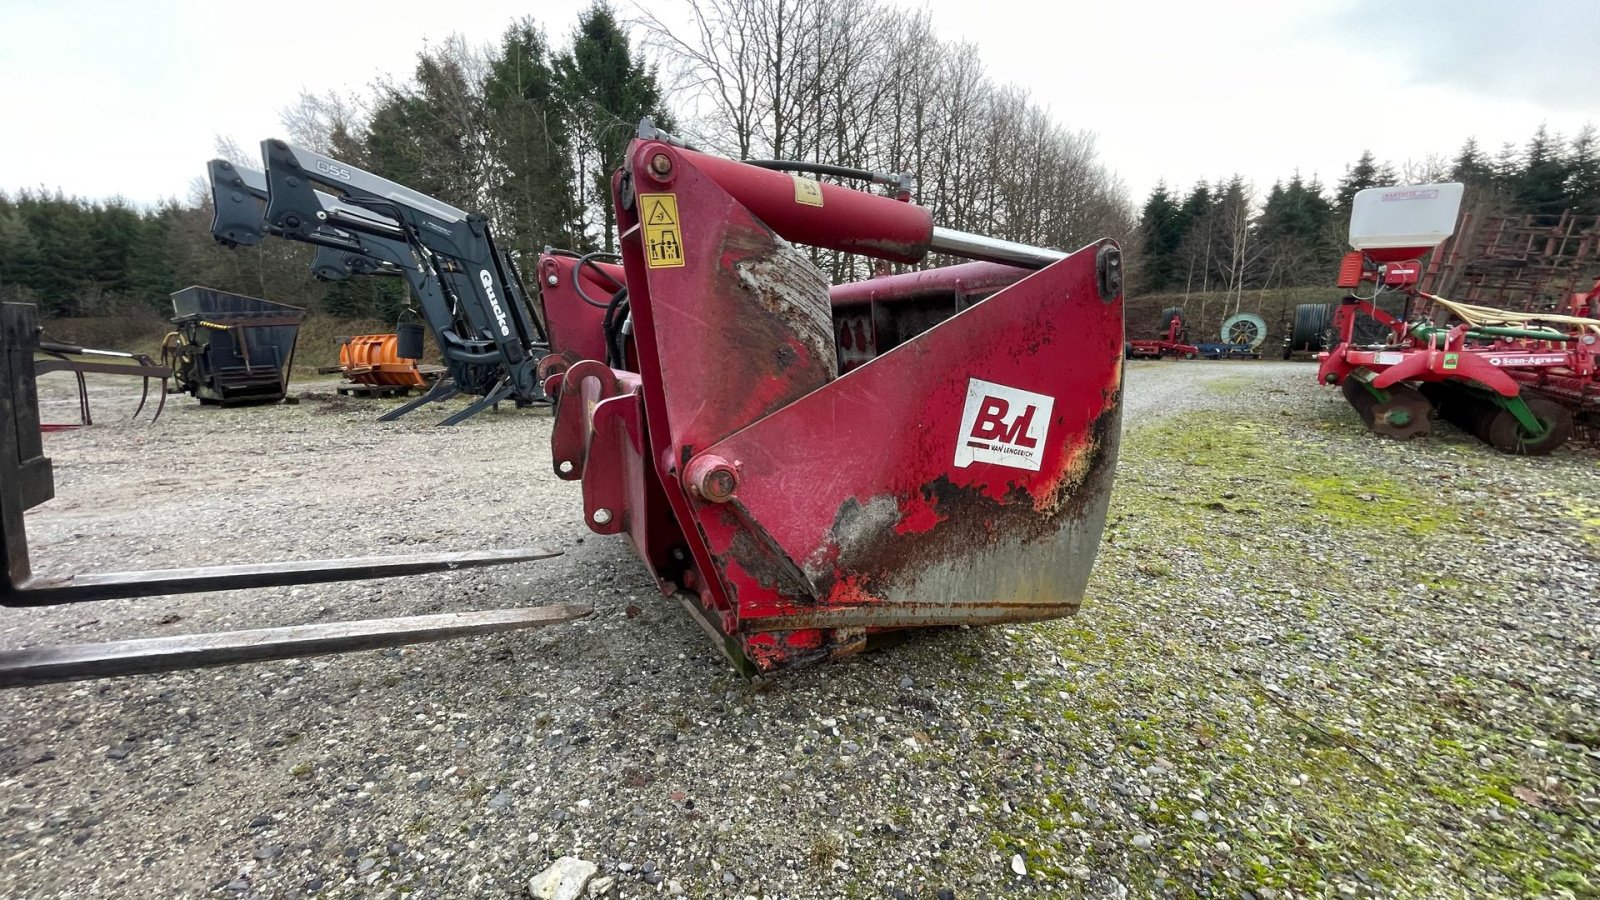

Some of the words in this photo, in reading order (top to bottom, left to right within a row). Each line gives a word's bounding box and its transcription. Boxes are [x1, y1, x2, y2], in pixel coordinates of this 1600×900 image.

[480, 269, 510, 337] Quicke
[1502, 356, 1552, 366] Scan-Agro
[991, 445, 1004, 453] VAN
[1003, 447, 1034, 457] LENGERICH
